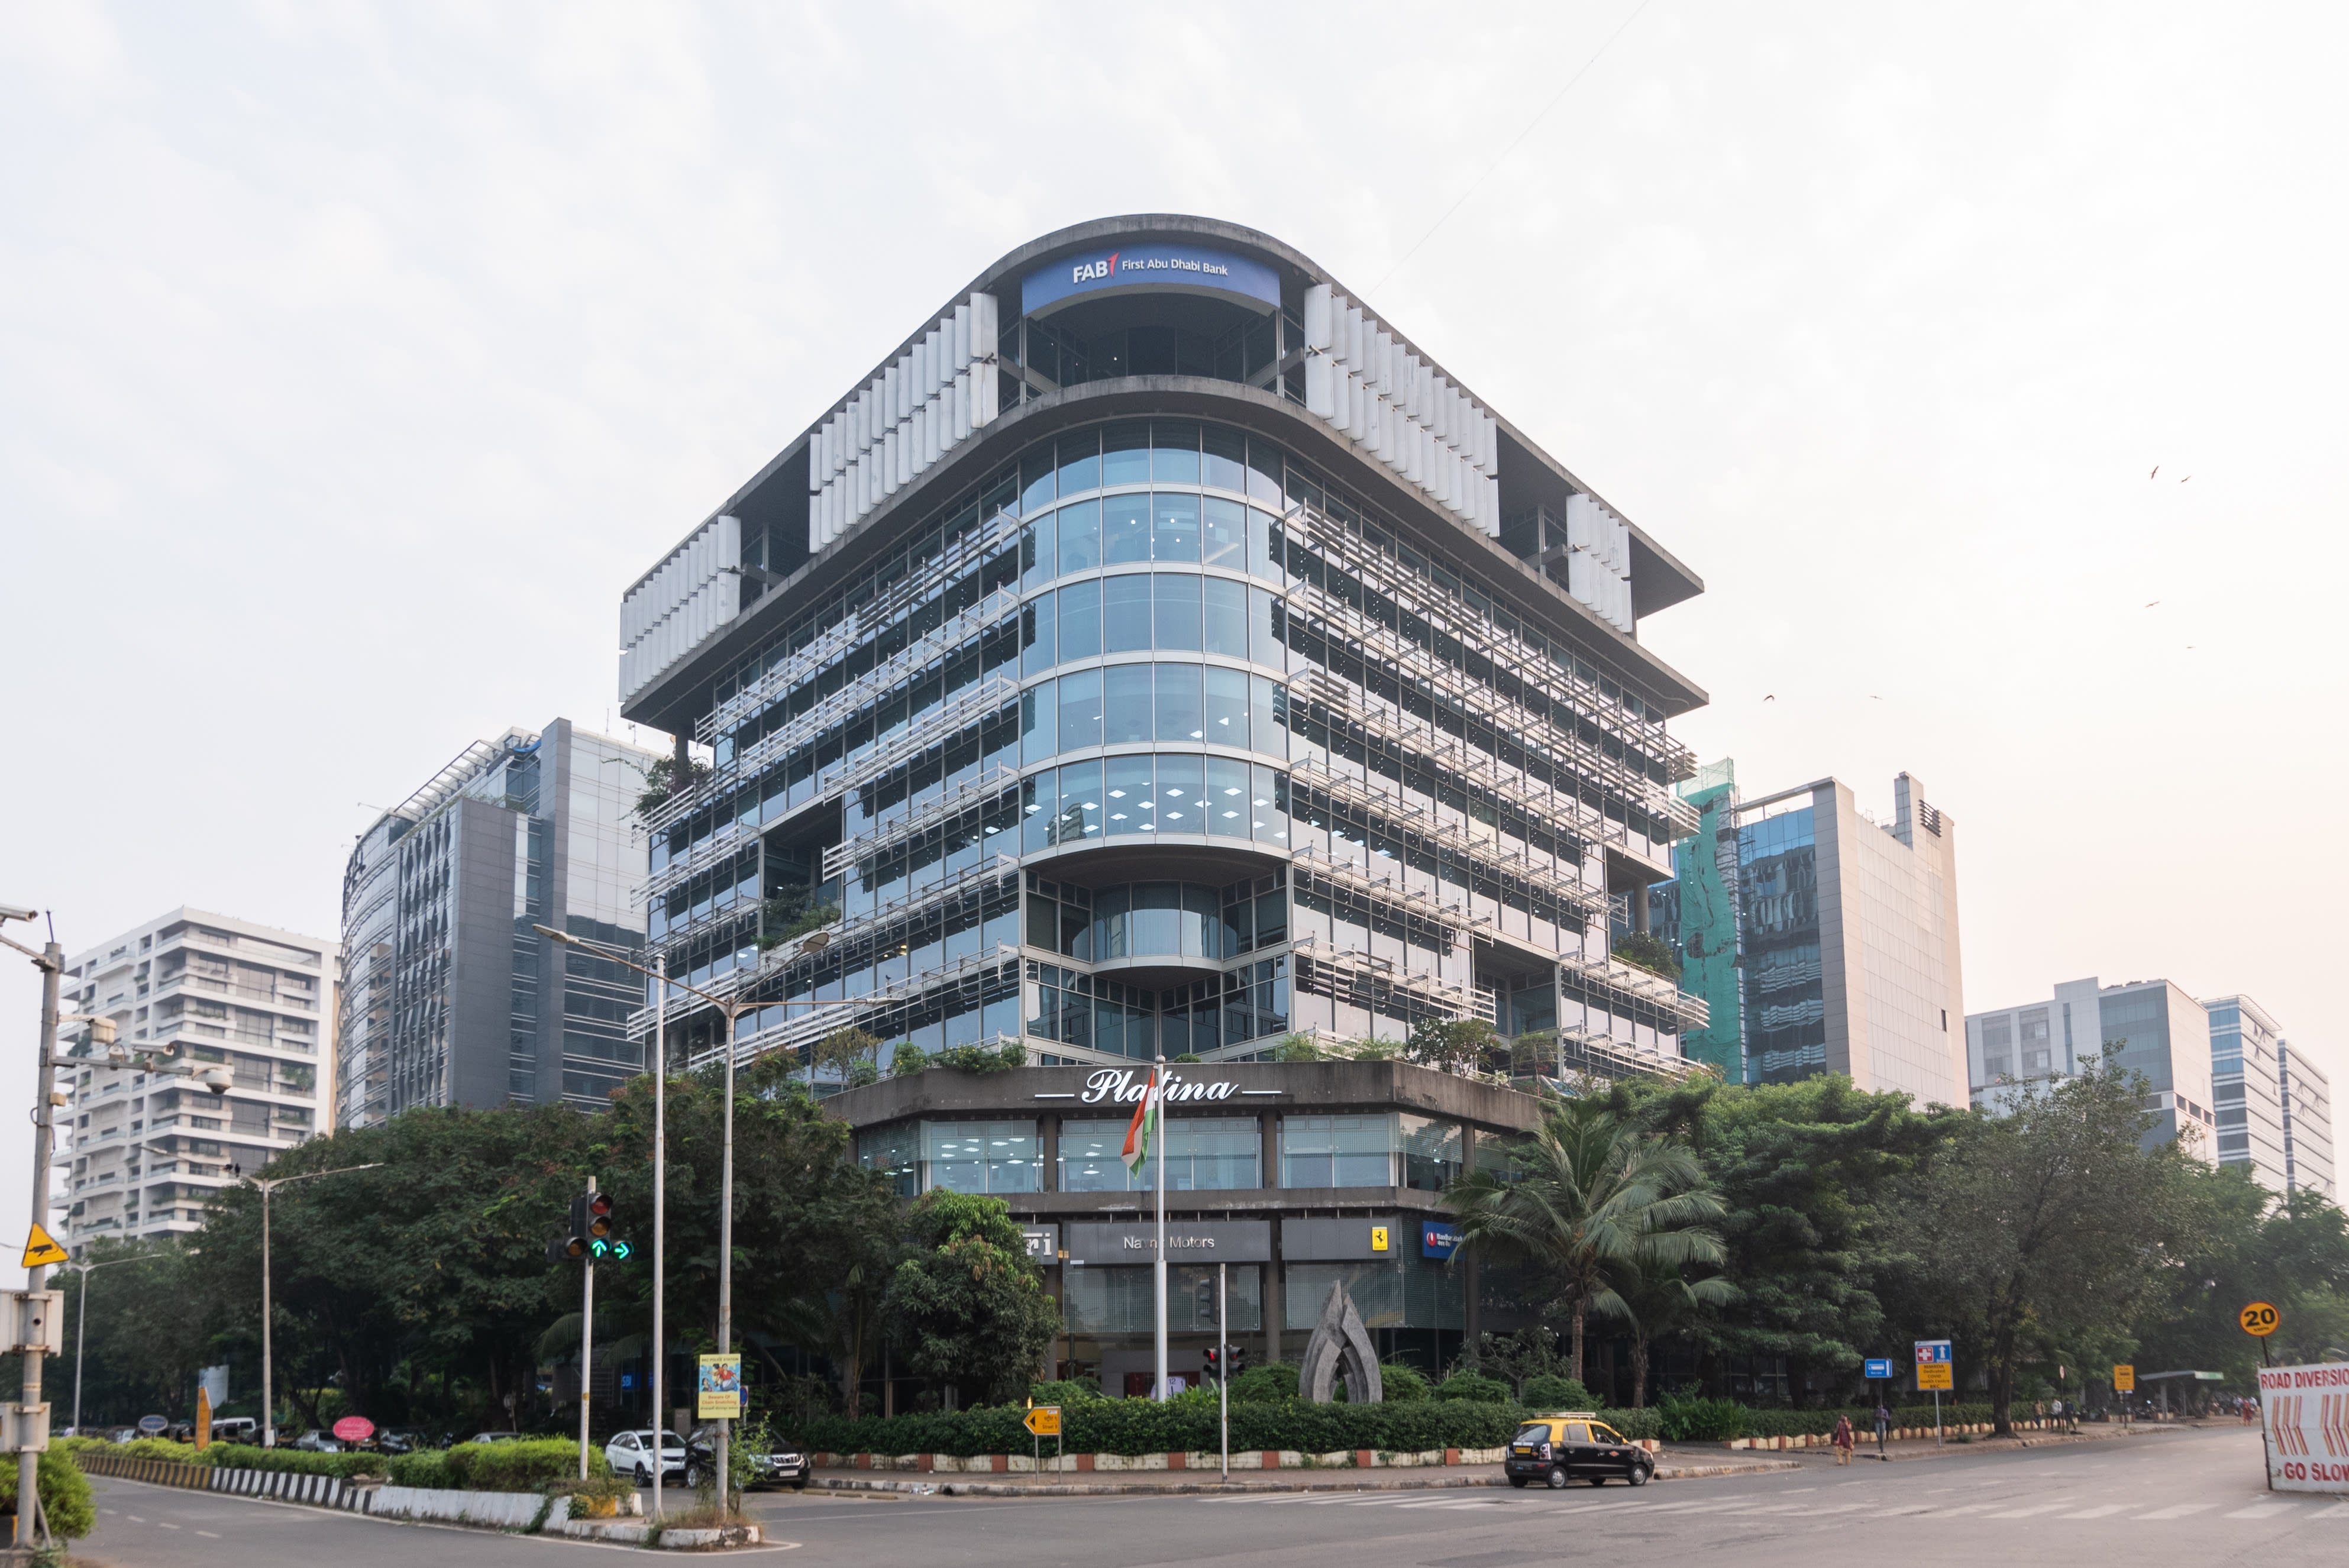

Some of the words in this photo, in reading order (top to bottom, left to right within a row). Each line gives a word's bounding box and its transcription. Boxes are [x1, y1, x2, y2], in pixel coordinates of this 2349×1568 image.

[1073, 261, 1108, 283] FAB
[1122, 260, 1145, 270] First
[1147, 259, 1168, 269] Abu
[1171, 259, 1200, 271] Dhabi
[1203, 263, 1228, 276] Bank
[1124, 1236, 1164, 1249] Navn
[1170, 1236, 1215, 1249] Motors
[2244, 1308, 2276, 1327] 20
[2260, 1372, 2291, 1389] ROAD
[2295, 1367, 2349, 1388] DIVERSIO
[2285, 1462, 2306, 1480] GO
